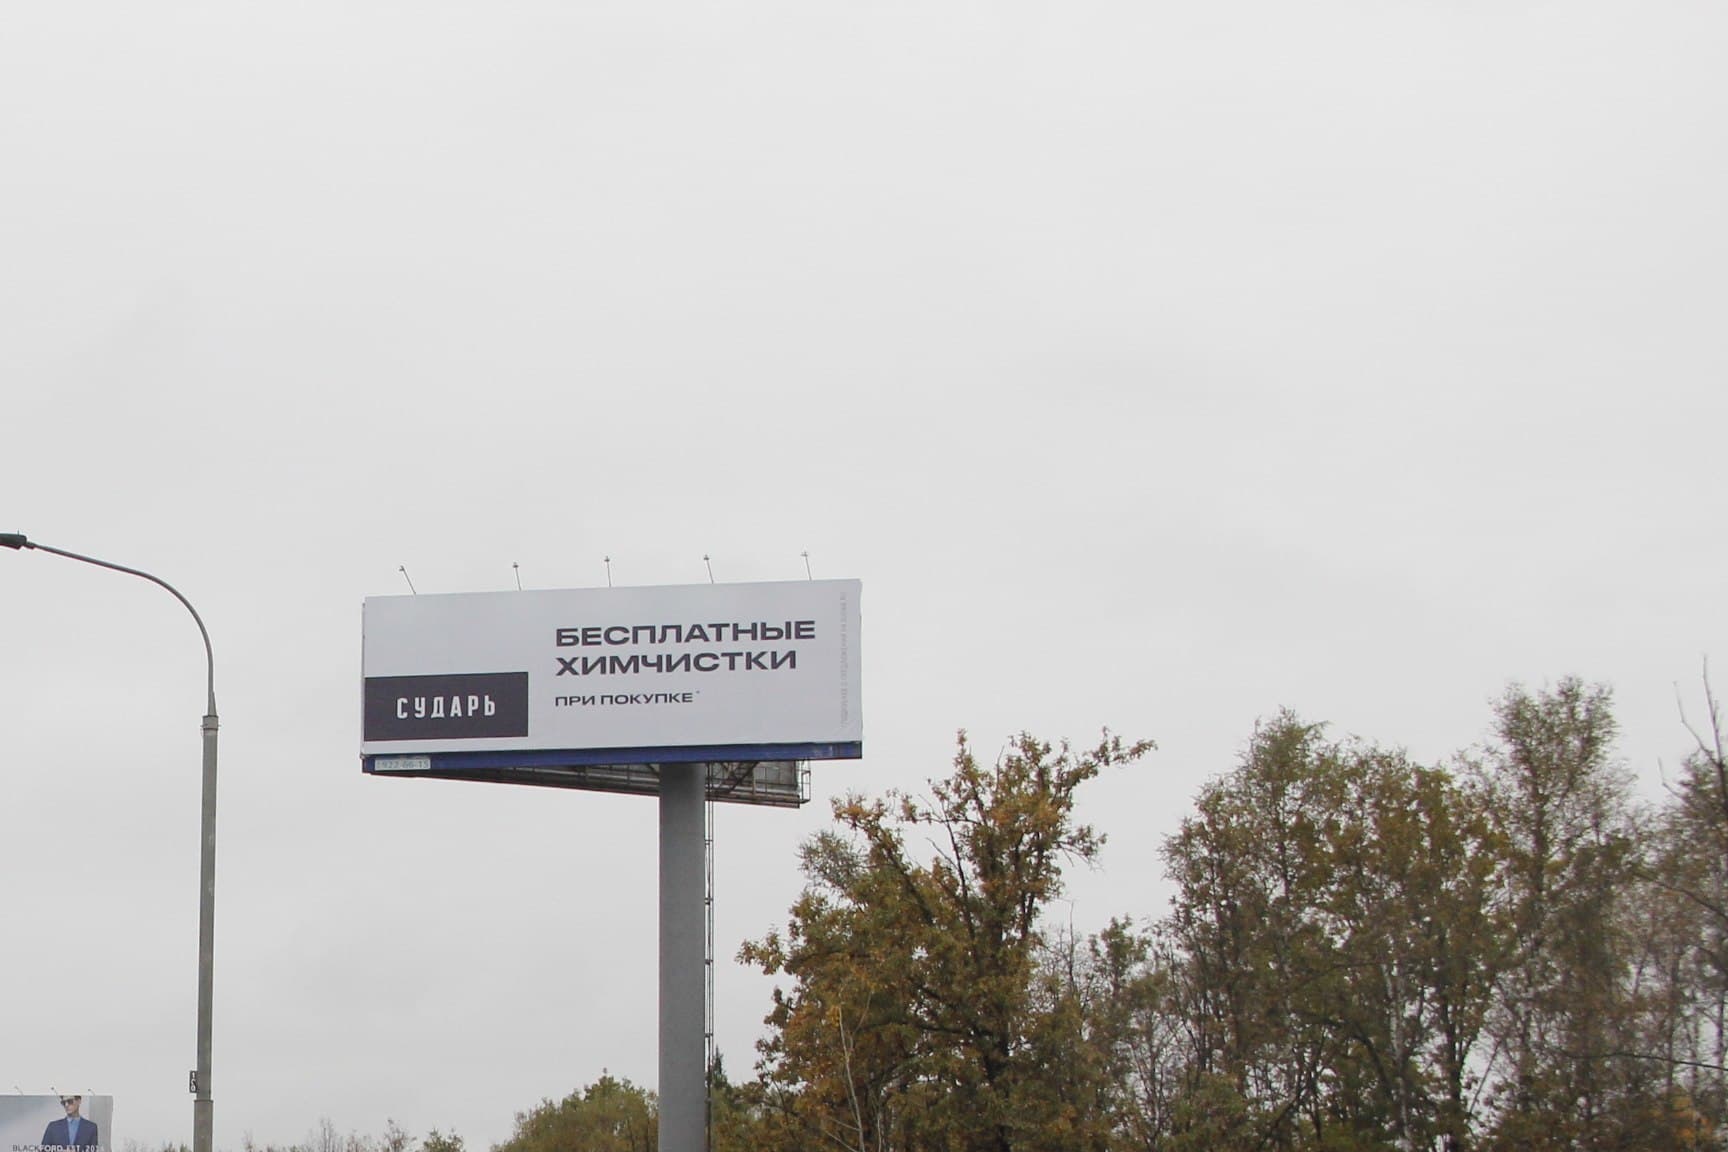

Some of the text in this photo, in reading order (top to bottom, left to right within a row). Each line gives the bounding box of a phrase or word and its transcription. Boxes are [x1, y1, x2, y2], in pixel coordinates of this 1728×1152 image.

[555, 620, 816, 647] БЕСПЛАТНЫЕ
[555, 650, 797, 677] ХИМЧИСТКИ
[396, 694, 496, 719] СУДАРЬ
[554, 695, 596, 707] ПРИ
